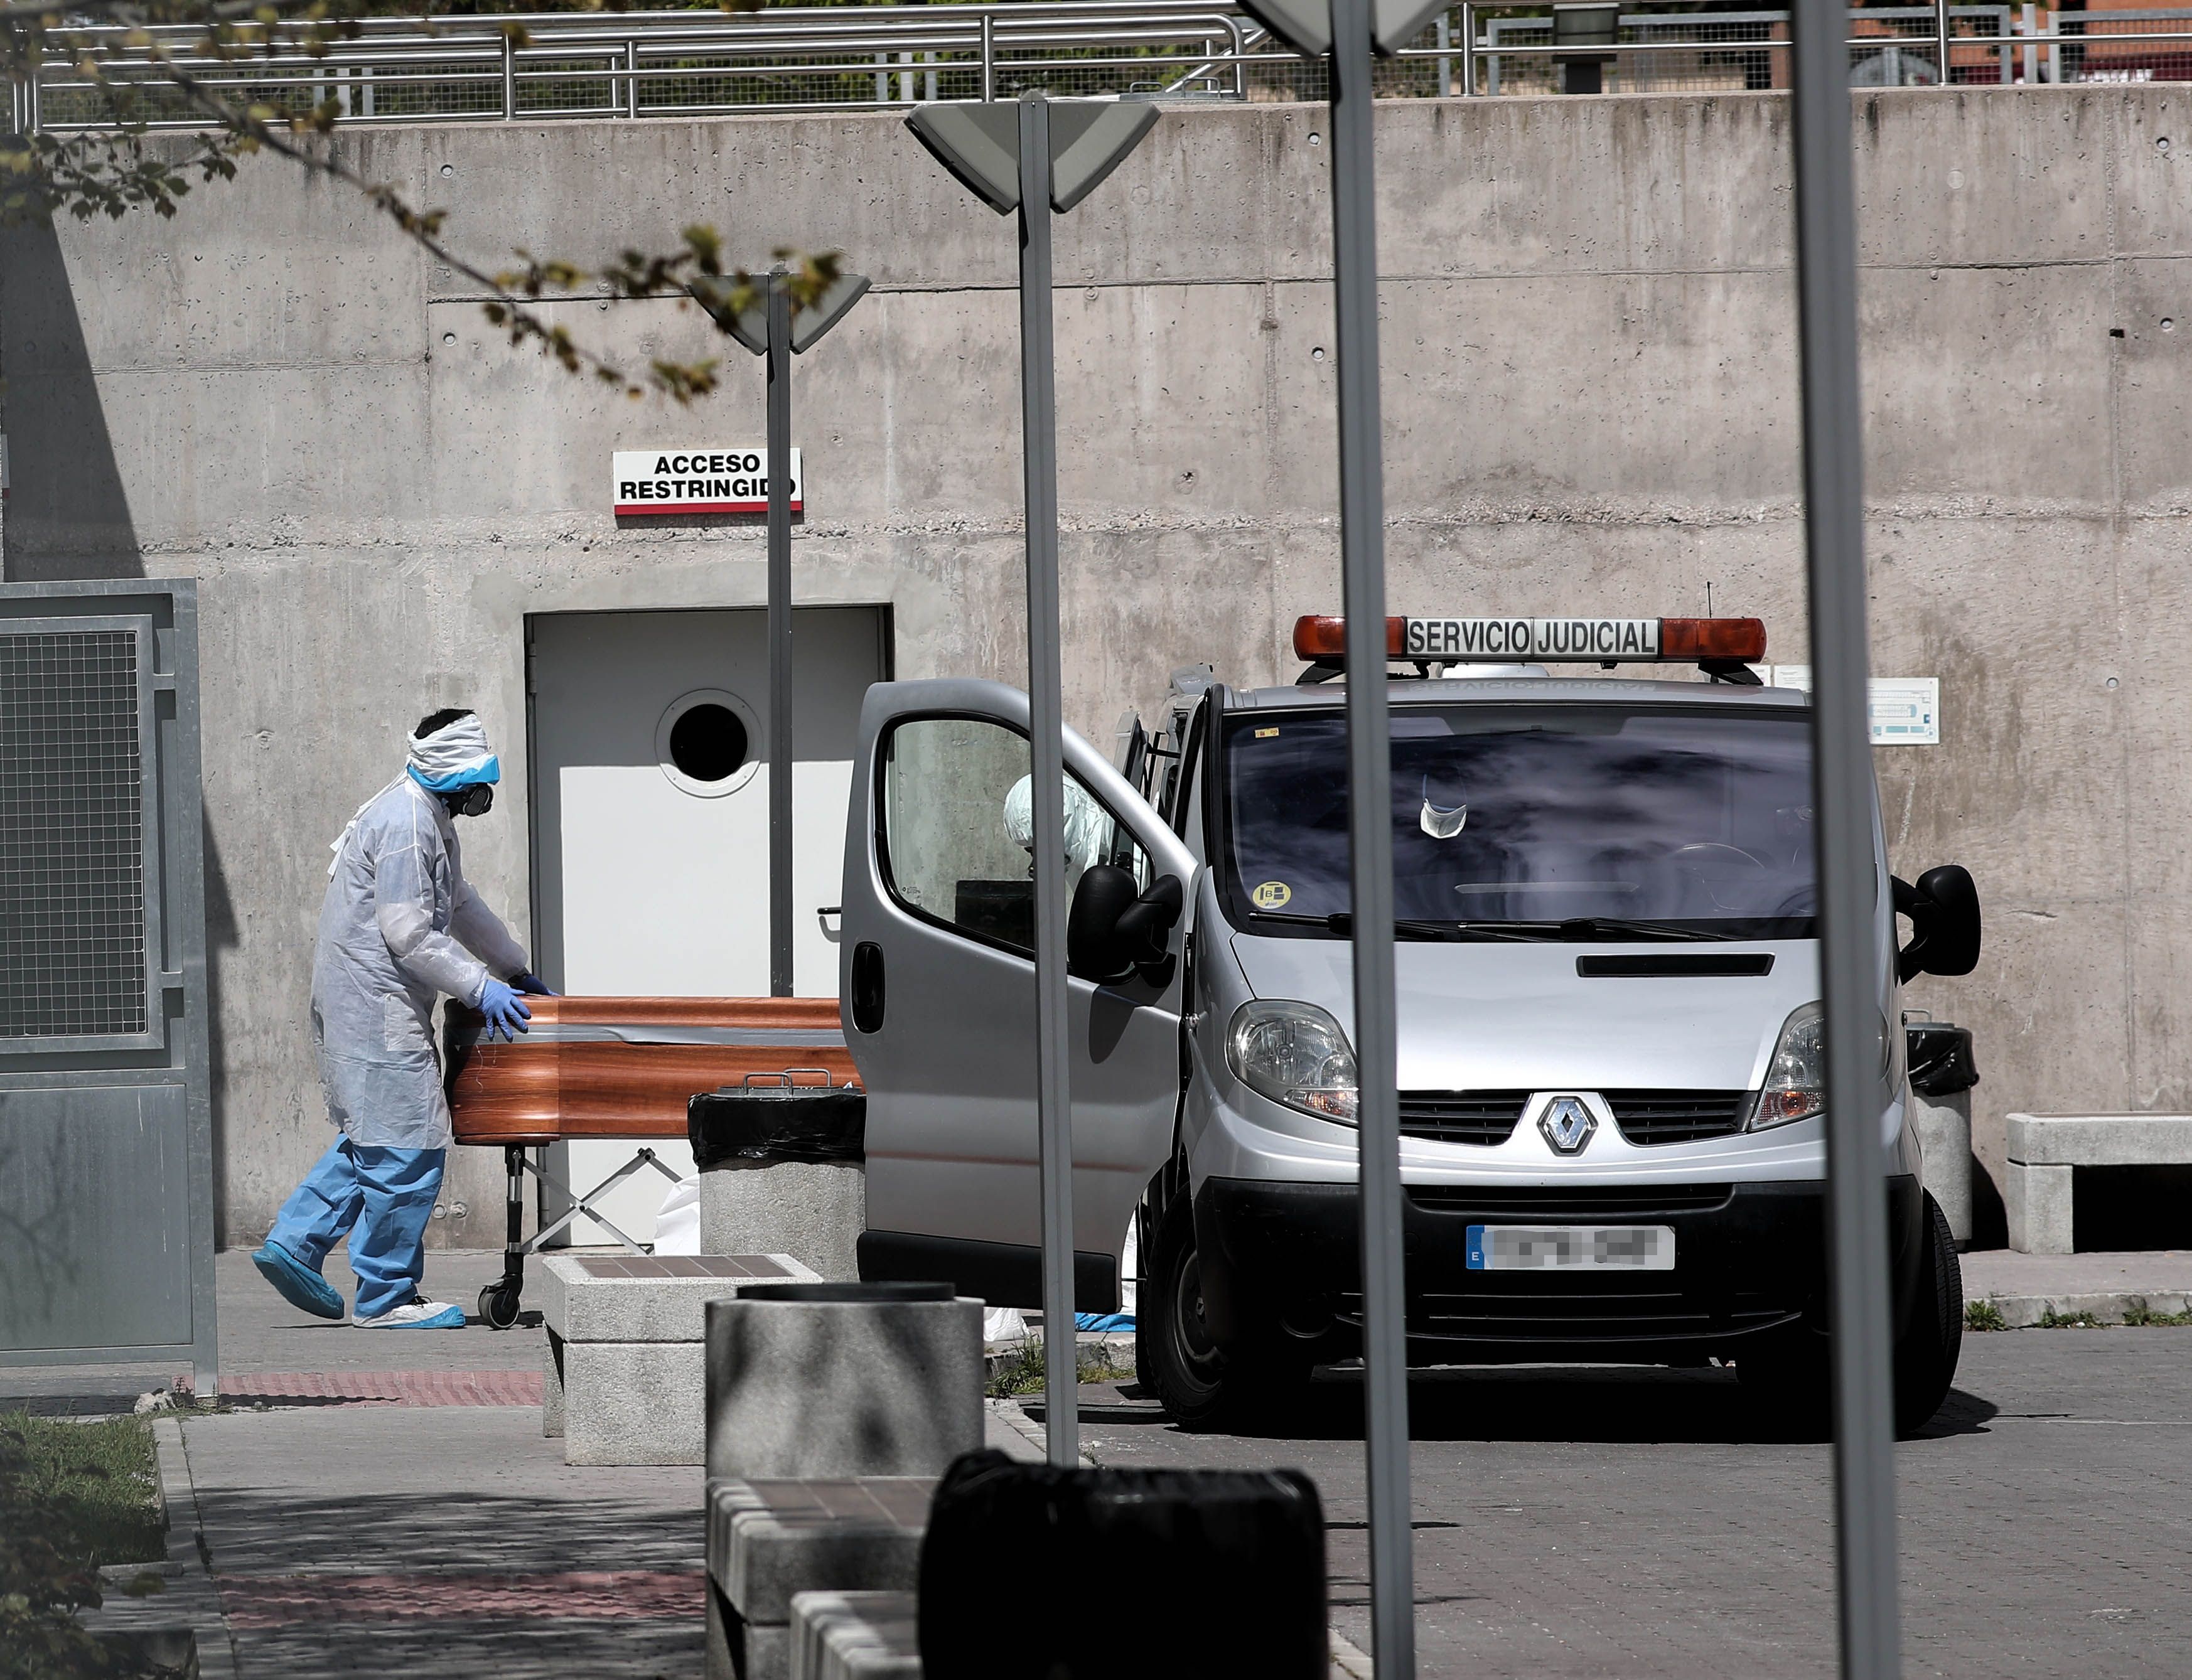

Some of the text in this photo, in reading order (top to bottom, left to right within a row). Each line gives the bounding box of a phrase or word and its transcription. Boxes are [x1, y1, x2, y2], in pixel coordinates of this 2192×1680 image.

[654, 454, 760, 474] ACCESO
[620, 478, 796, 499] RESTRINGI
[1409, 621, 1655, 653] SERVICIO JUDICIAL
[1472, 1251, 1480, 1261] E
